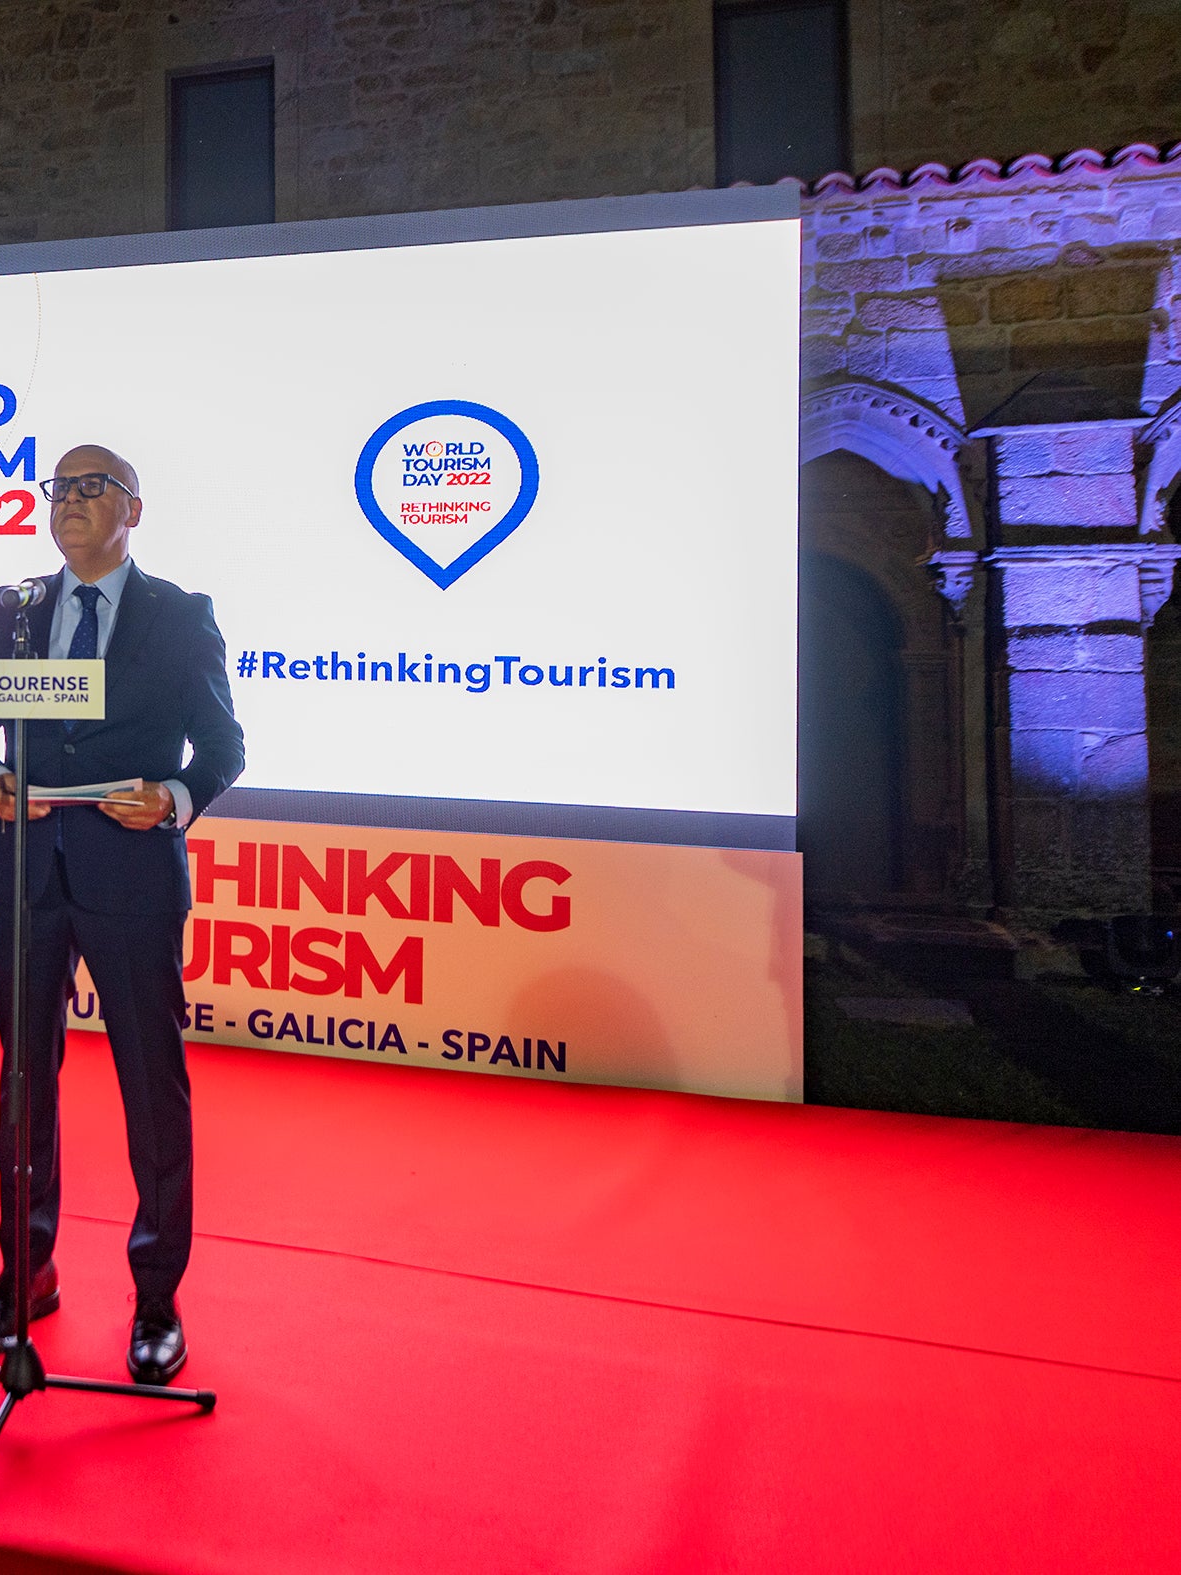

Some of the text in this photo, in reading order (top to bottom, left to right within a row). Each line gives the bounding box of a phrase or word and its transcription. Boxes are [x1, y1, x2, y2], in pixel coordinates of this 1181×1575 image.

[403, 441, 485, 457] WORLD
[402, 457, 491, 471] TOURISM
[403, 472, 491, 486] DAY 2022
[401, 501, 491, 513] RETHINKING
[400, 513, 468, 525] TOURISM
[237, 651, 676, 693] #RethinkingTourism
[54, 693, 89, 703] SPAIN
[248, 1009, 408, 1055] GALICIA
[441, 1029, 567, 1073] SPAIN
